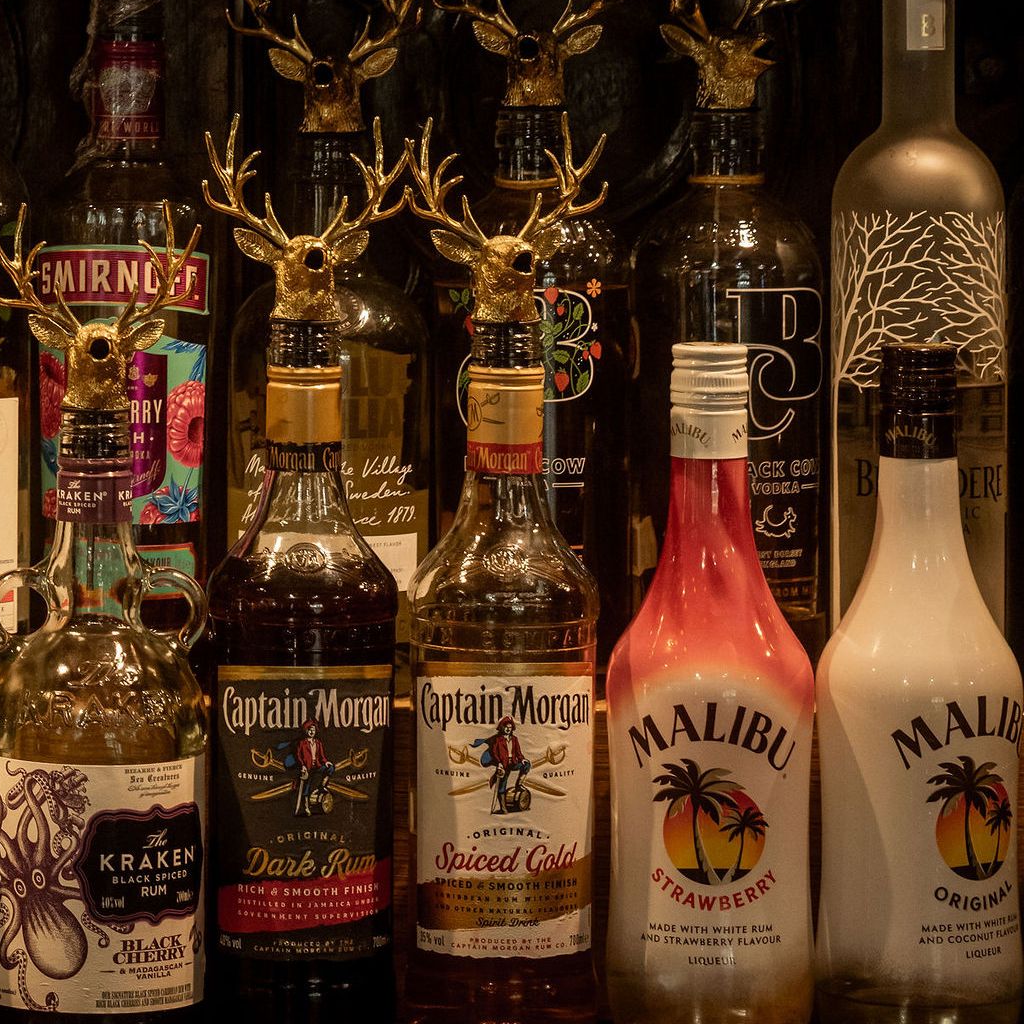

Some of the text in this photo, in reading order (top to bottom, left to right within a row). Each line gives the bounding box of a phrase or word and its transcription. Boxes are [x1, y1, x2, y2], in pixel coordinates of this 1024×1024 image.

[885, 426, 936, 447] MALIBU
[477, 447, 528, 471] Morgan
[362, 455, 414, 485] Village
[752, 481, 801, 495] VODKA
[57, 490, 102, 501] KRAKEN
[67, 507, 81, 515] RUM
[387, 506, 416, 524] 1879.
[223, 686, 391, 735] Captain Morgan
[421, 682, 589, 732] Captain Morgan
[628, 702, 796, 772] MALIBU
[435, 768, 575, 779] GENUINE QUALITY
[277, 831, 345, 844] ORIGINAL
[473, 827, 543, 840] ORIGINAL
[100, 848, 194, 872] KRAKEN
[243, 846, 377, 881] Dark Rum
[435, 840, 578, 878] Spiced Gold
[112, 870, 188, 884] BLACK SPICED
[141, 886, 167, 898] RUM
[238, 884, 338, 897] RICH SMOOTH
[434, 878, 577, 892] SPICED SMOOTH FINISH
[652, 867, 777, 912] STRAWBERRY
[934, 880, 1013, 912] ORIGINAL
[649, 922, 773, 934] MADE WITH WHITE RUM
[921, 922, 980, 933] MADE WITH
[120, 933, 182, 953] BLACK
[641, 932, 781, 946] AND STRAWBERRY FLAVOUR
[919, 932, 993, 945] AND COCONUT
[112, 946, 186, 965] CHERRY
[966, 946, 1001, 959] LIQUEUR
[128, 962, 183, 974] MADAGASCAN
[136, 970, 171, 980] VANILLA
